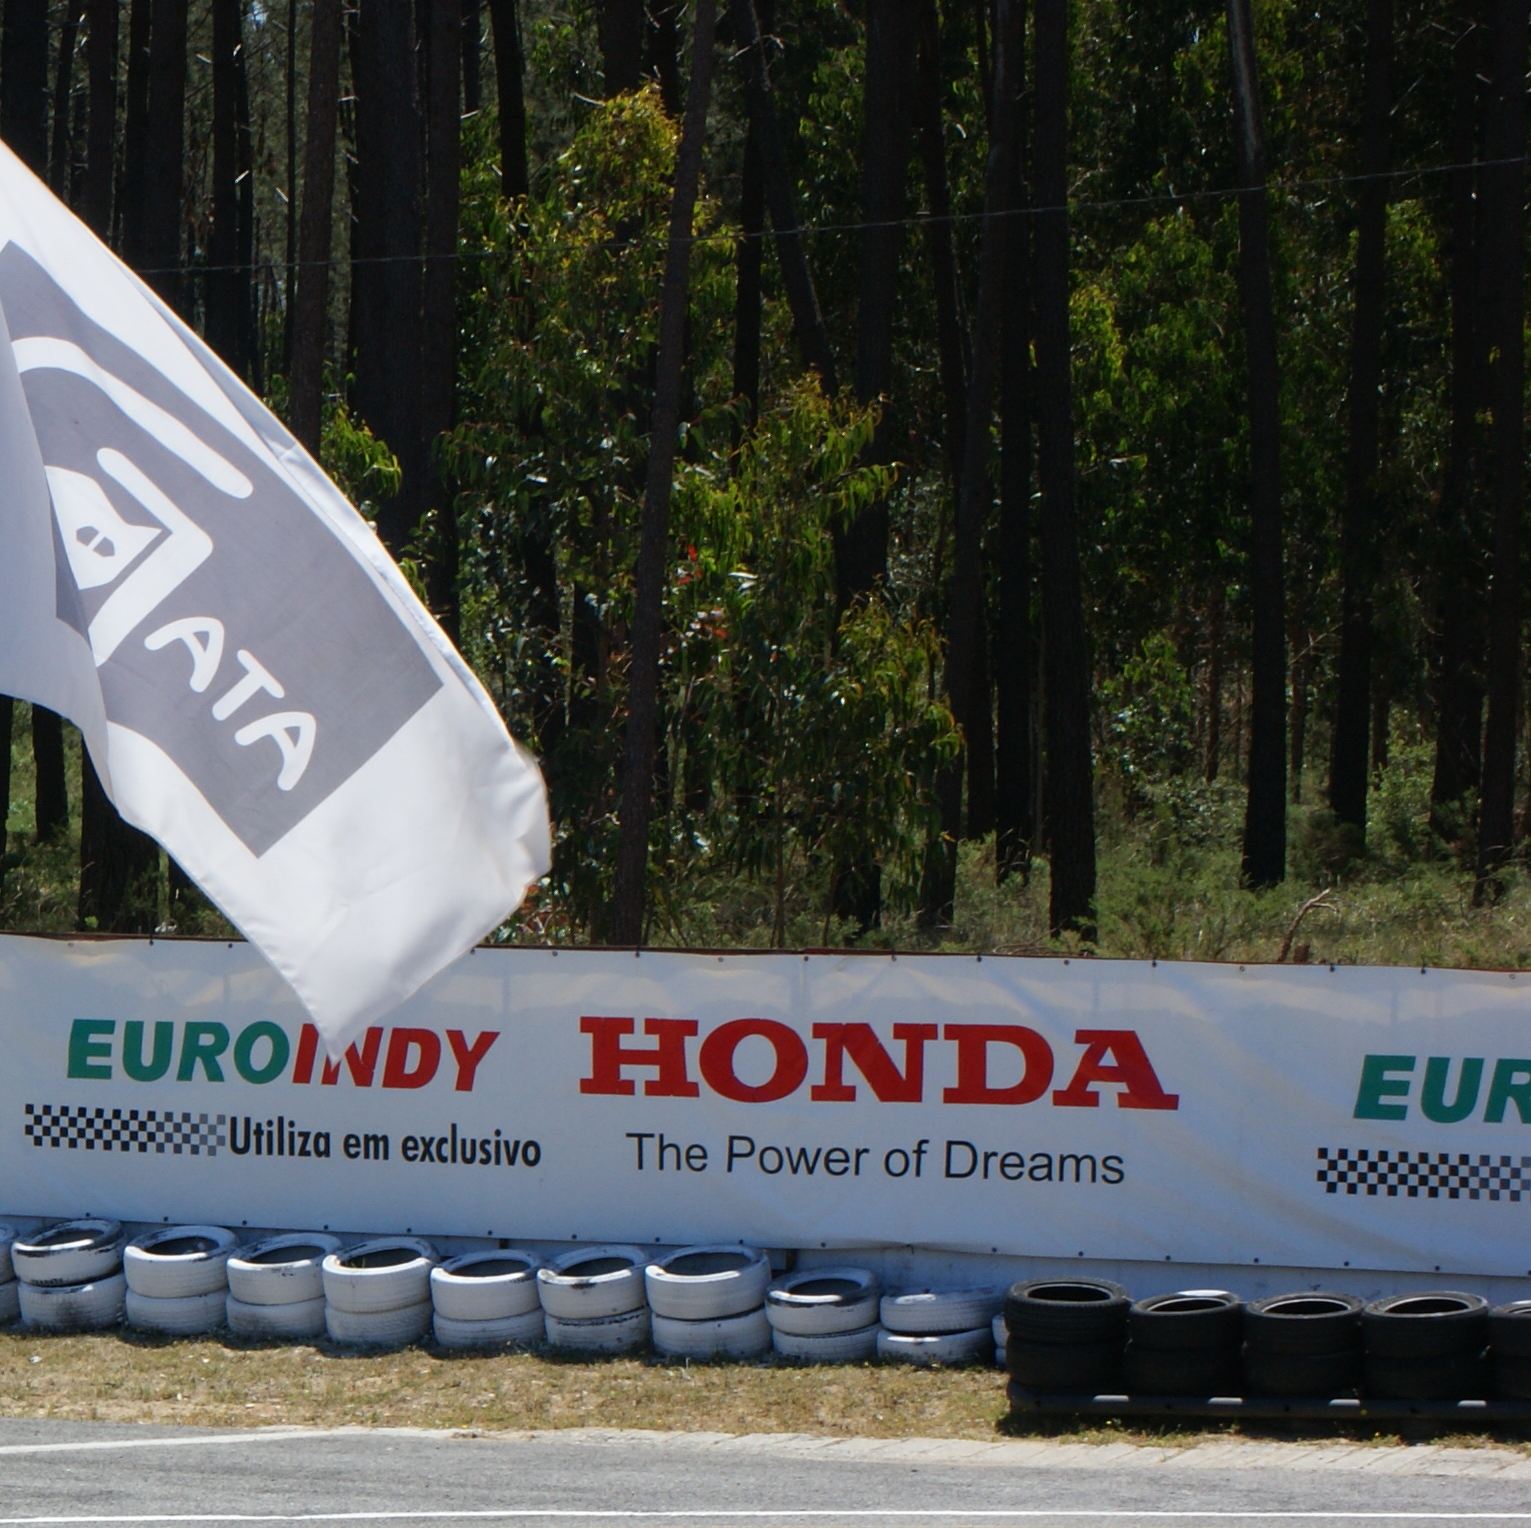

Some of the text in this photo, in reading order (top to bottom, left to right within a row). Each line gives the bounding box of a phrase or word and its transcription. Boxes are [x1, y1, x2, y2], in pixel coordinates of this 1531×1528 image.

[67, 1018, 501, 1092] EUROINDY
[579, 1016, 1180, 1111] HONDA
[228, 1115, 542, 1168] Utiliza em exclusivo
[626, 1132, 1126, 1185] The Power of Dreams
